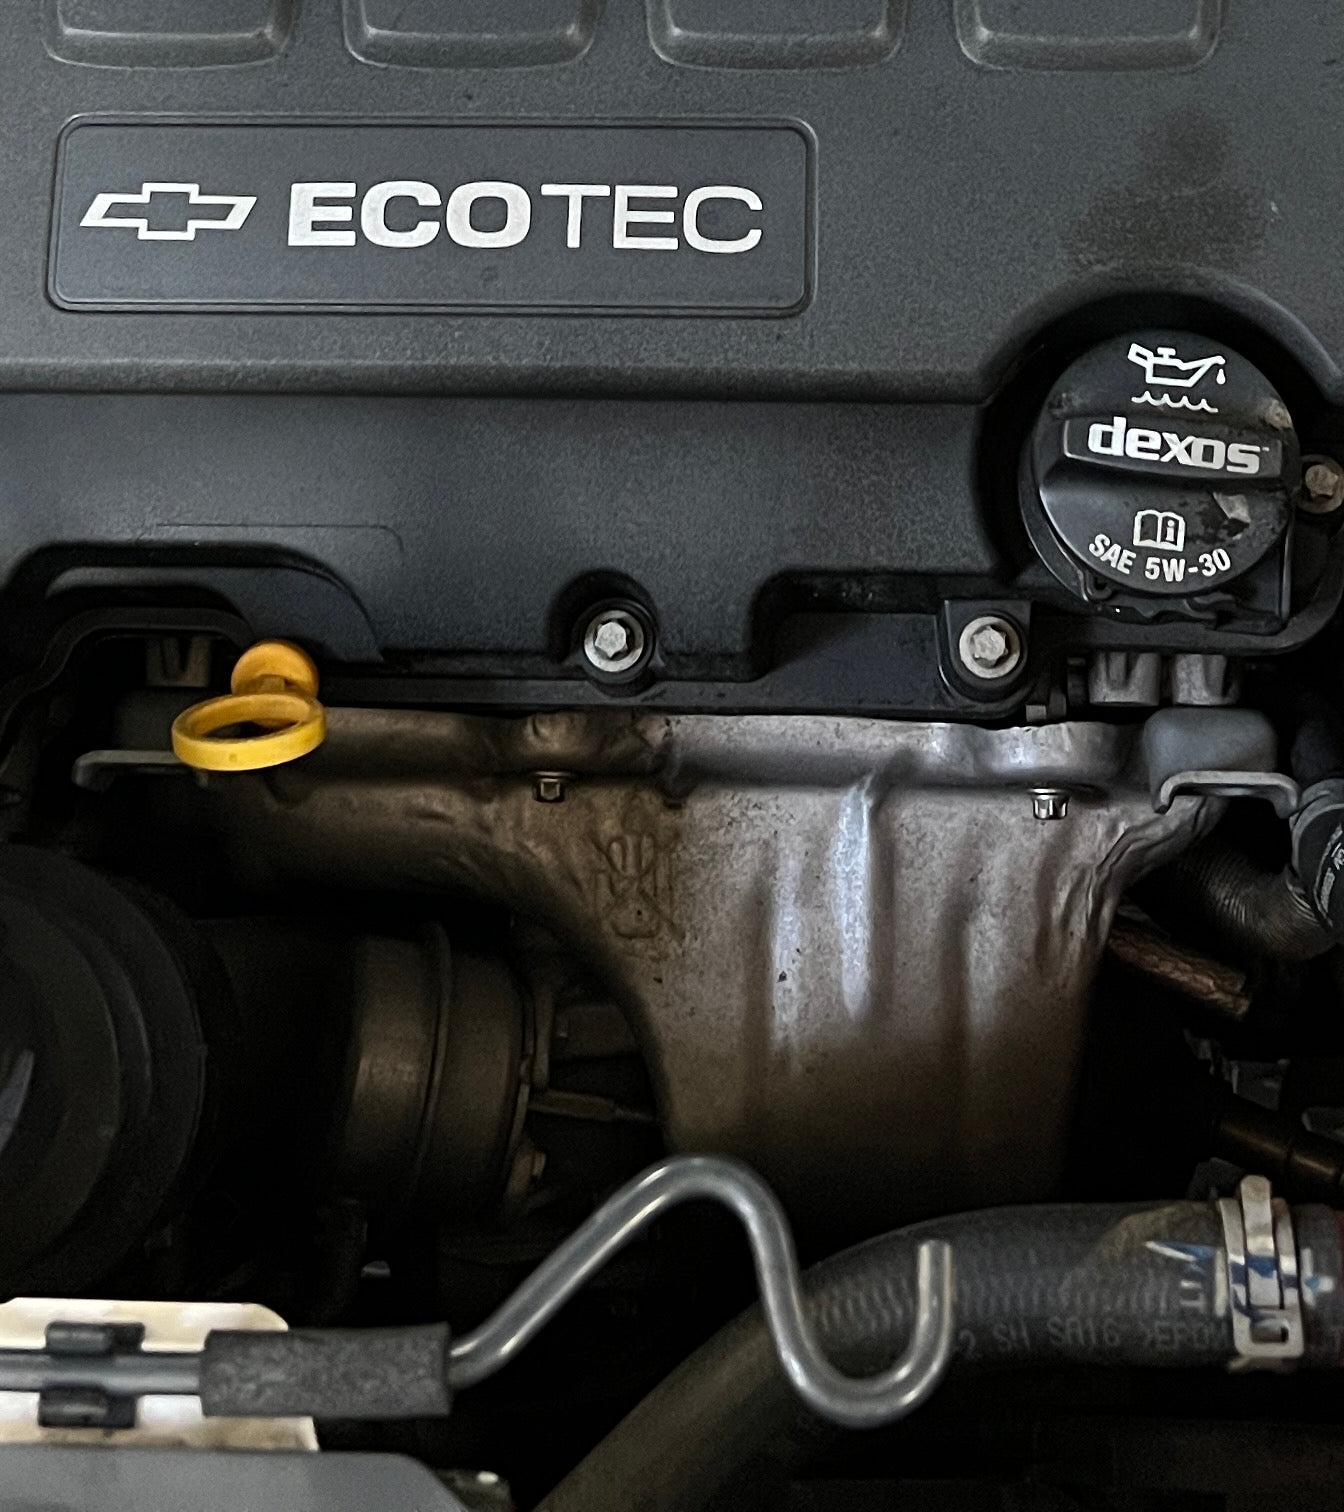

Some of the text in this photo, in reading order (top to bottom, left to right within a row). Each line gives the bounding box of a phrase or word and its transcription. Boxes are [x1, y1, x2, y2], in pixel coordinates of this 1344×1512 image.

[287, 179, 764, 254] ECOTEC
[1089, 534, 1232, 582] SAE 5W-30
